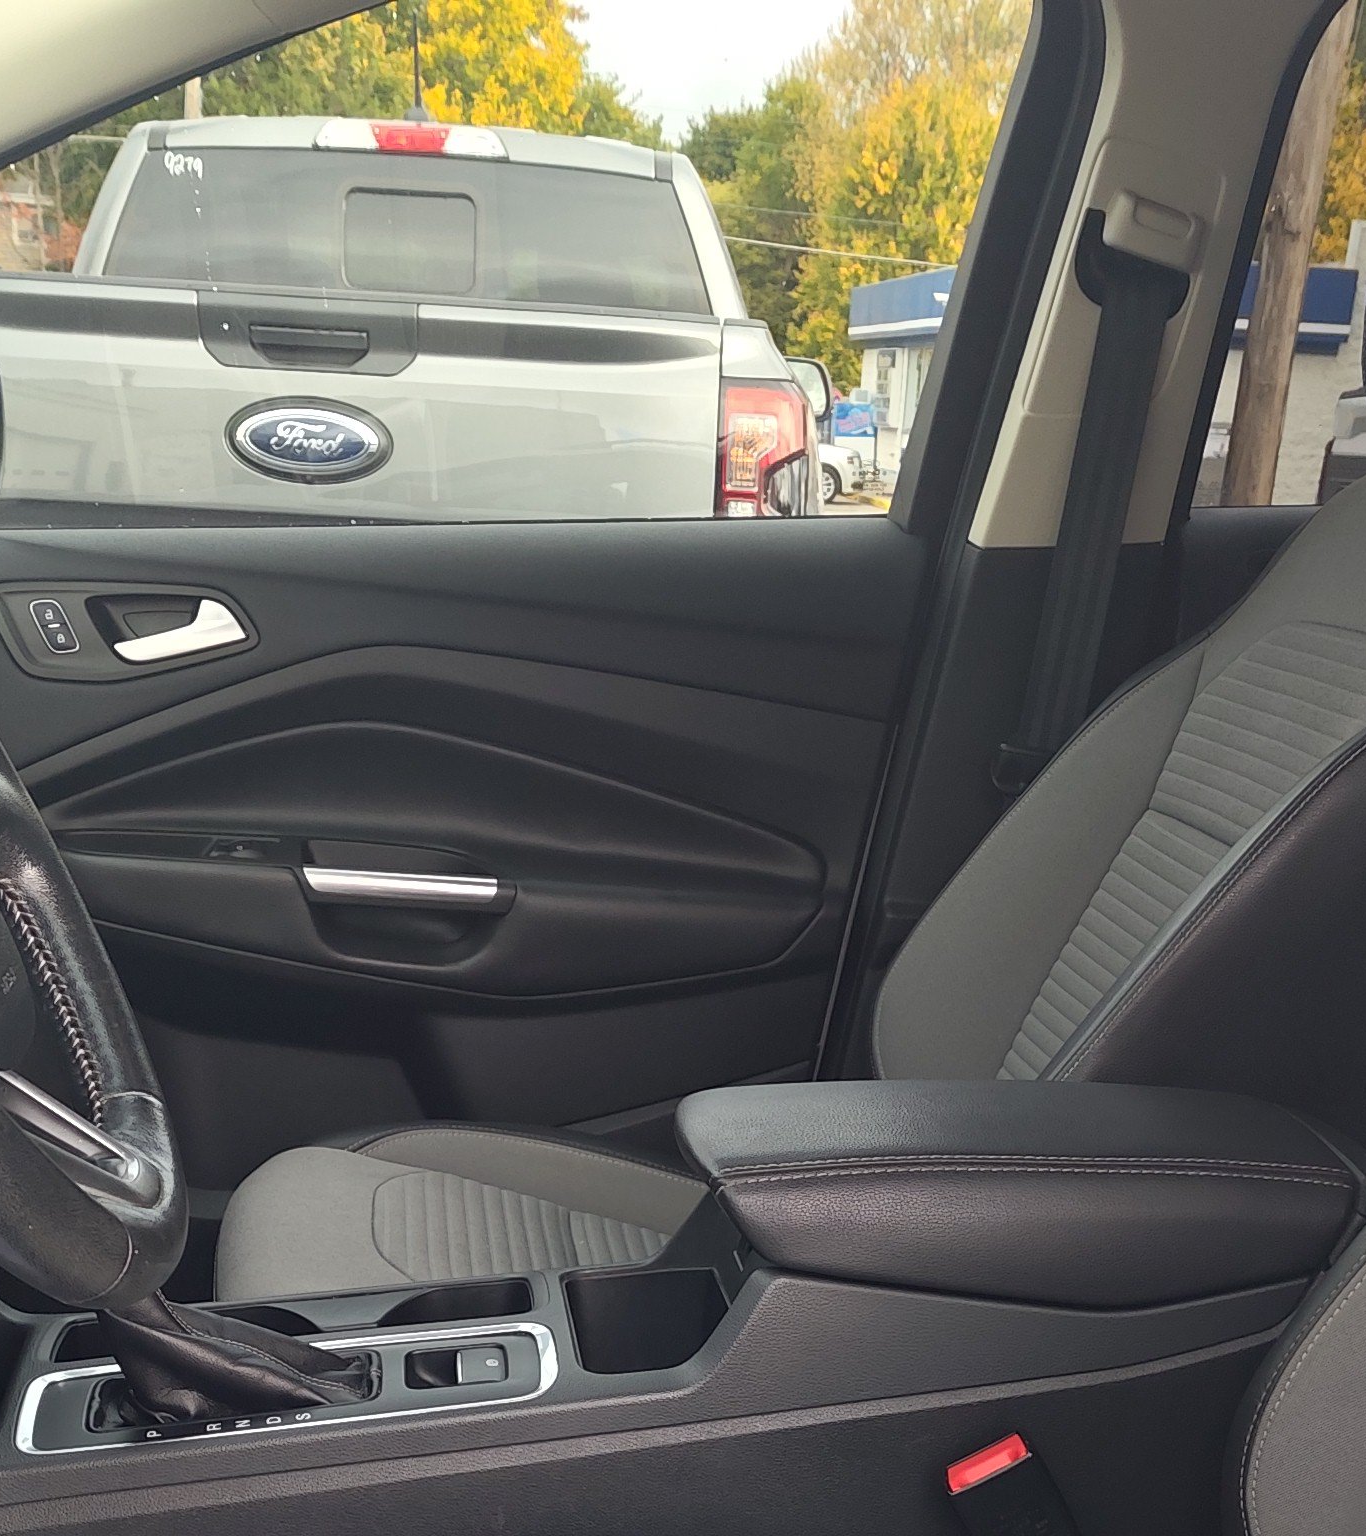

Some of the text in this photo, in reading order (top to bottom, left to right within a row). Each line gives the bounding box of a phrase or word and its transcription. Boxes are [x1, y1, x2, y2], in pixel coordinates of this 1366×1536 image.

[270, 421, 345, 455] Ford
[266, 1416, 281, 1425] D
[295, 1412, 311, 1421] S
[206, 1422, 222, 1431] R
[147, 1430, 161, 1438] P
